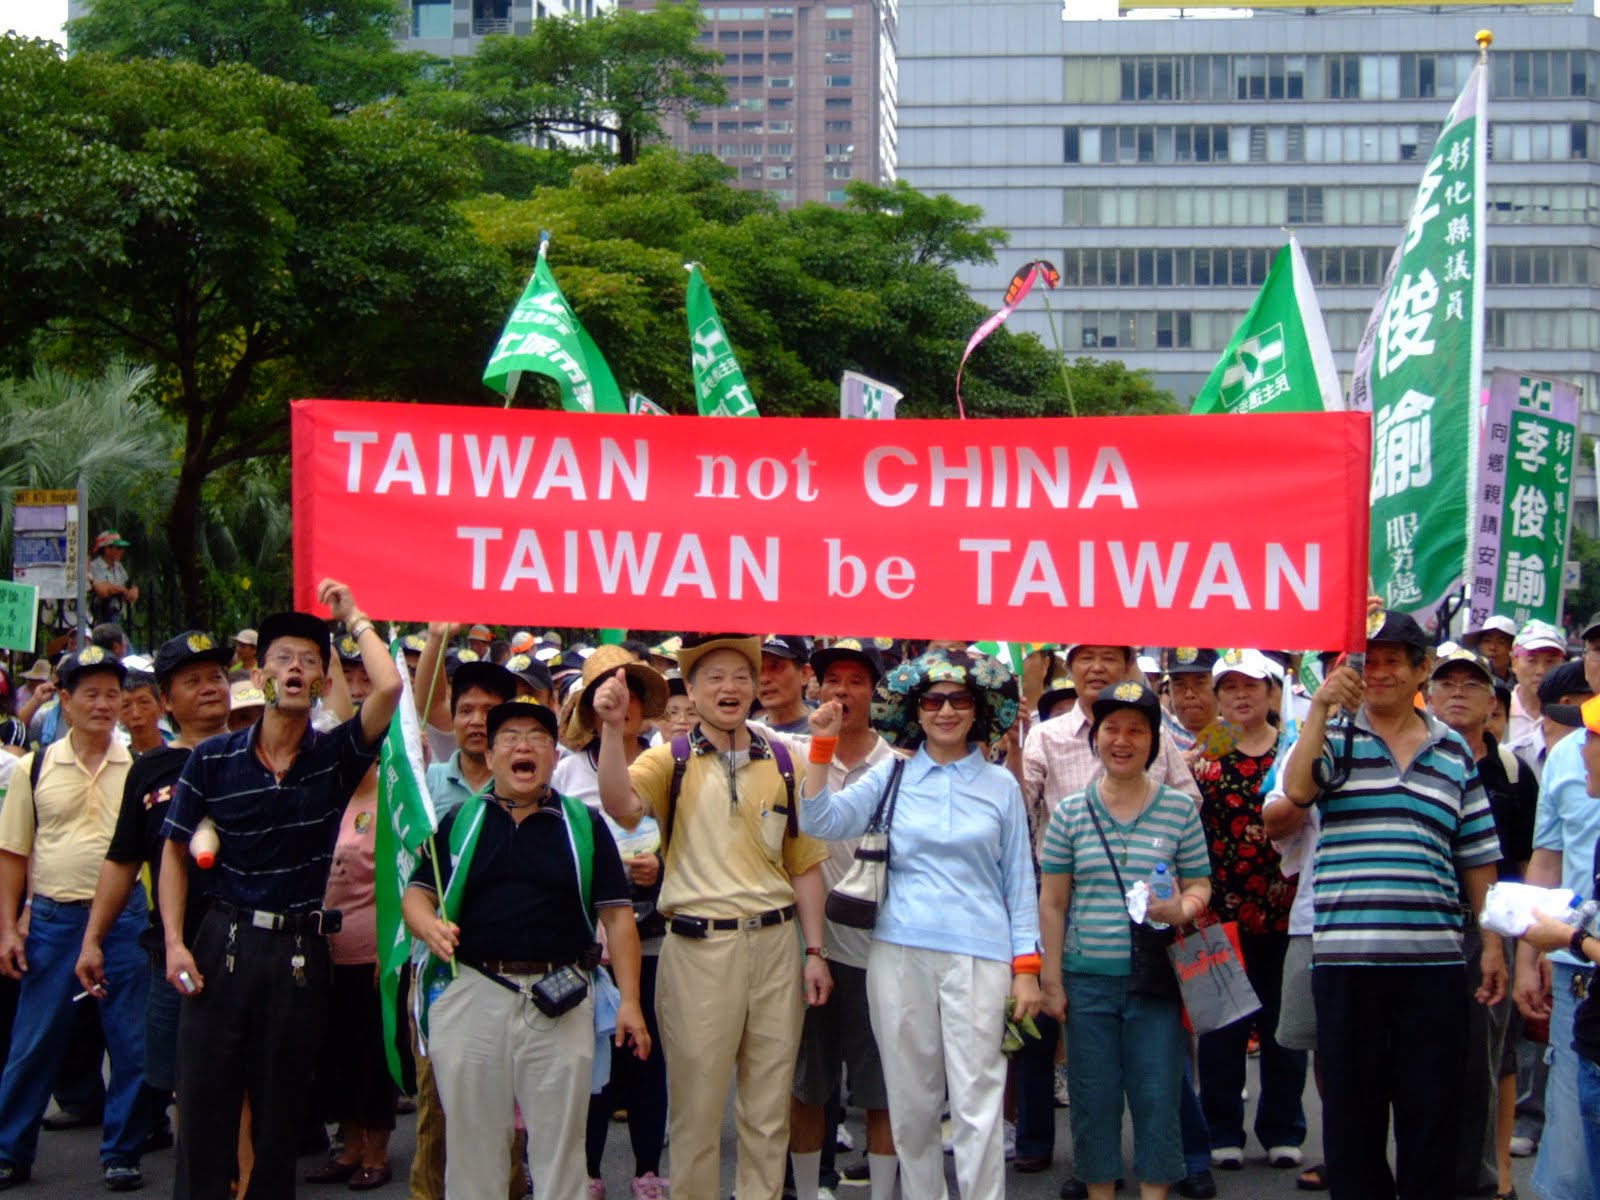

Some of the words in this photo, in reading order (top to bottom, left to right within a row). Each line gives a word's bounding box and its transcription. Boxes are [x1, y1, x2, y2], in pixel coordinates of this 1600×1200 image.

[1444, 136, 1472, 322] 彰化縣議員
[333, 431, 649, 502] TAIWAN
[695, 446, 819, 503] not
[864, 445, 1139, 509] CHINA
[1502, 420, 1550, 608] 李俊諭
[457, 526, 780, 602] TAIWAN
[824, 538, 916, 600] be
[959, 538, 1320, 611] TAIWAN
